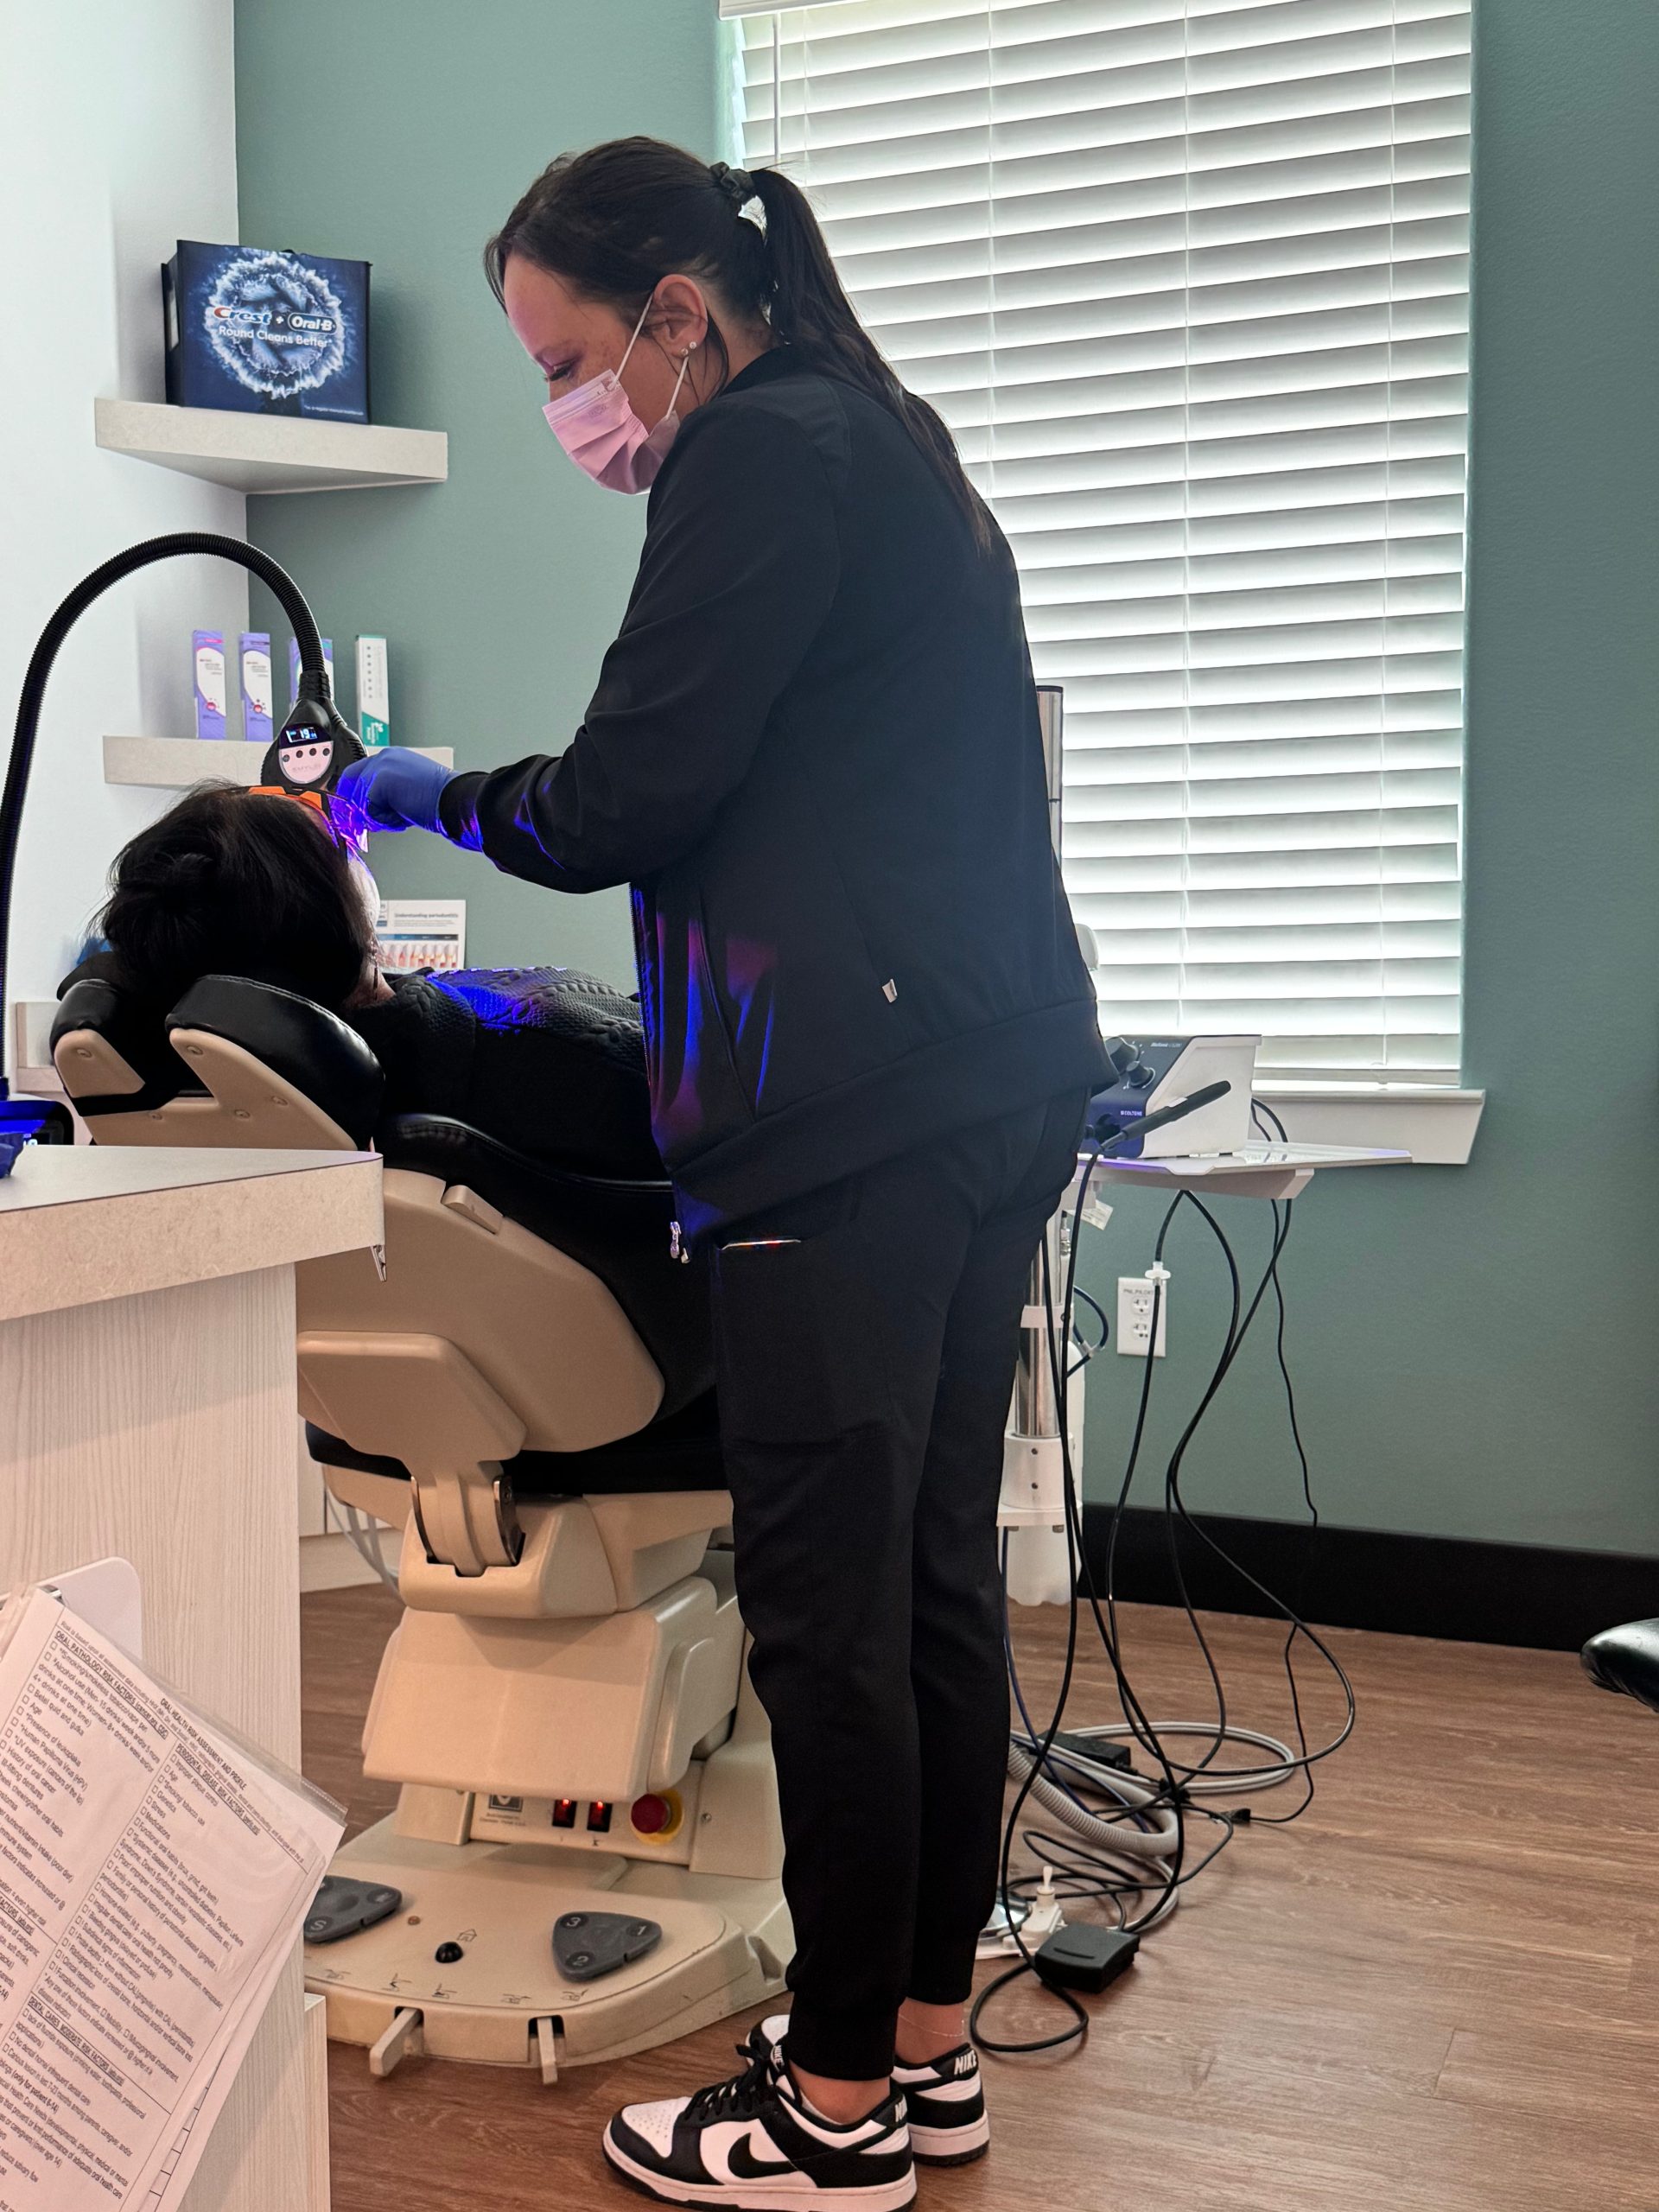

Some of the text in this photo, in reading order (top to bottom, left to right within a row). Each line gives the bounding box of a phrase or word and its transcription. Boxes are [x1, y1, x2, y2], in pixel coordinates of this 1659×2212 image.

[213, 307, 272, 325] Crest
[219, 325, 254, 339] Round
[257, 330, 294, 344] Cleans
[37, 1661, 56, 1681] drinks
[55, 1629, 136, 1705] ORAL PATHOLOGY RISK FACTORS
[34, 1688, 49, 1706] Betel
[48, 1700, 61, 1716] quid
[41, 1679, 60, 1700] drinks
[76, 1709, 92, 1728] time)
[120, 1720, 134, 1736] week
[159, 1697, 173, 1713] ORAL
[170, 1709, 189, 1730] HEALTH
[186, 1725, 198, 1738] RISK
[196, 1735, 224, 1766] ASSESSMENT
[229, 1770, 246, 1790] PROFILE
[23, 1745, 47, 1770] exposure
[39, 1740, 64, 1767] Papilloma
[61, 1761, 75, 1777] Virus
[72, 1773, 88, 1792] (HPV)
[6, 1745, 26, 1768] History
[30, 1766, 41, 1781] oral
[40, 1777, 56, 1795] cancer
[174, 1758, 194, 1782] Improper
[175, 1742, 245, 1816] PERIODONTAL DISEASE RISK FACTORS
[21, 1776, 44, 1801] dentures
[150, 1800, 167, 1819] Stress
[156, 1789, 177, 1813] Genetics
[181, 1798, 199, 1819] tobacco
[41, 1811, 52, 1825] oral
[144, 1810, 171, 1840] Medications
[15, 1841, 33, 1862] system
[36, 1844, 53, 1862] intake
[310, 1919, 327, 1931] S
[566, 1916, 582, 1927] 3
[637, 1925, 646, 1936] 1
[573, 1955, 589, 1967] 2
[953, 2049, 977, 2075] NIKE
